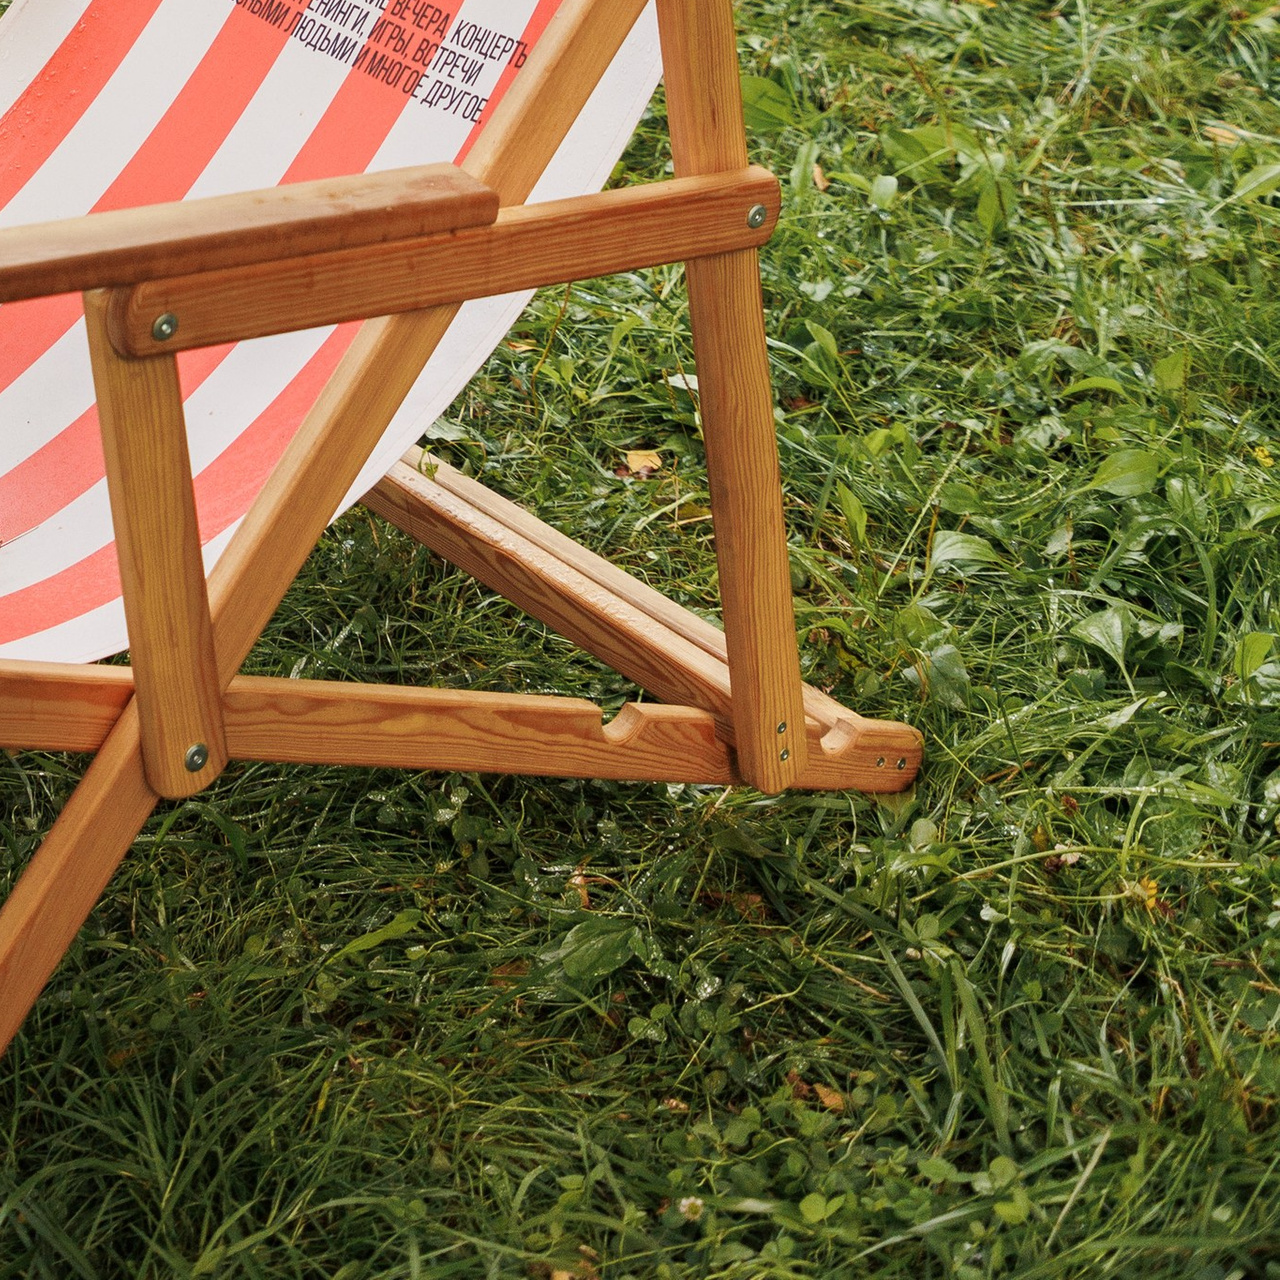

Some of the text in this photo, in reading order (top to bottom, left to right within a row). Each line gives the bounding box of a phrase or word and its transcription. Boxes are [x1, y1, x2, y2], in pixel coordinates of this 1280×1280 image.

[283, 11, 358, 64] ЛЮДЬМИ
[351, 44, 371, 68] И
[363, 50, 430, 98] МНОГОЕ
[420, 79, 490, 124] ДРУГОЕ.
[367, 16, 415, 60] ИГРЫ,
[412, 38, 485, 86] ВСТРЕЧИ
